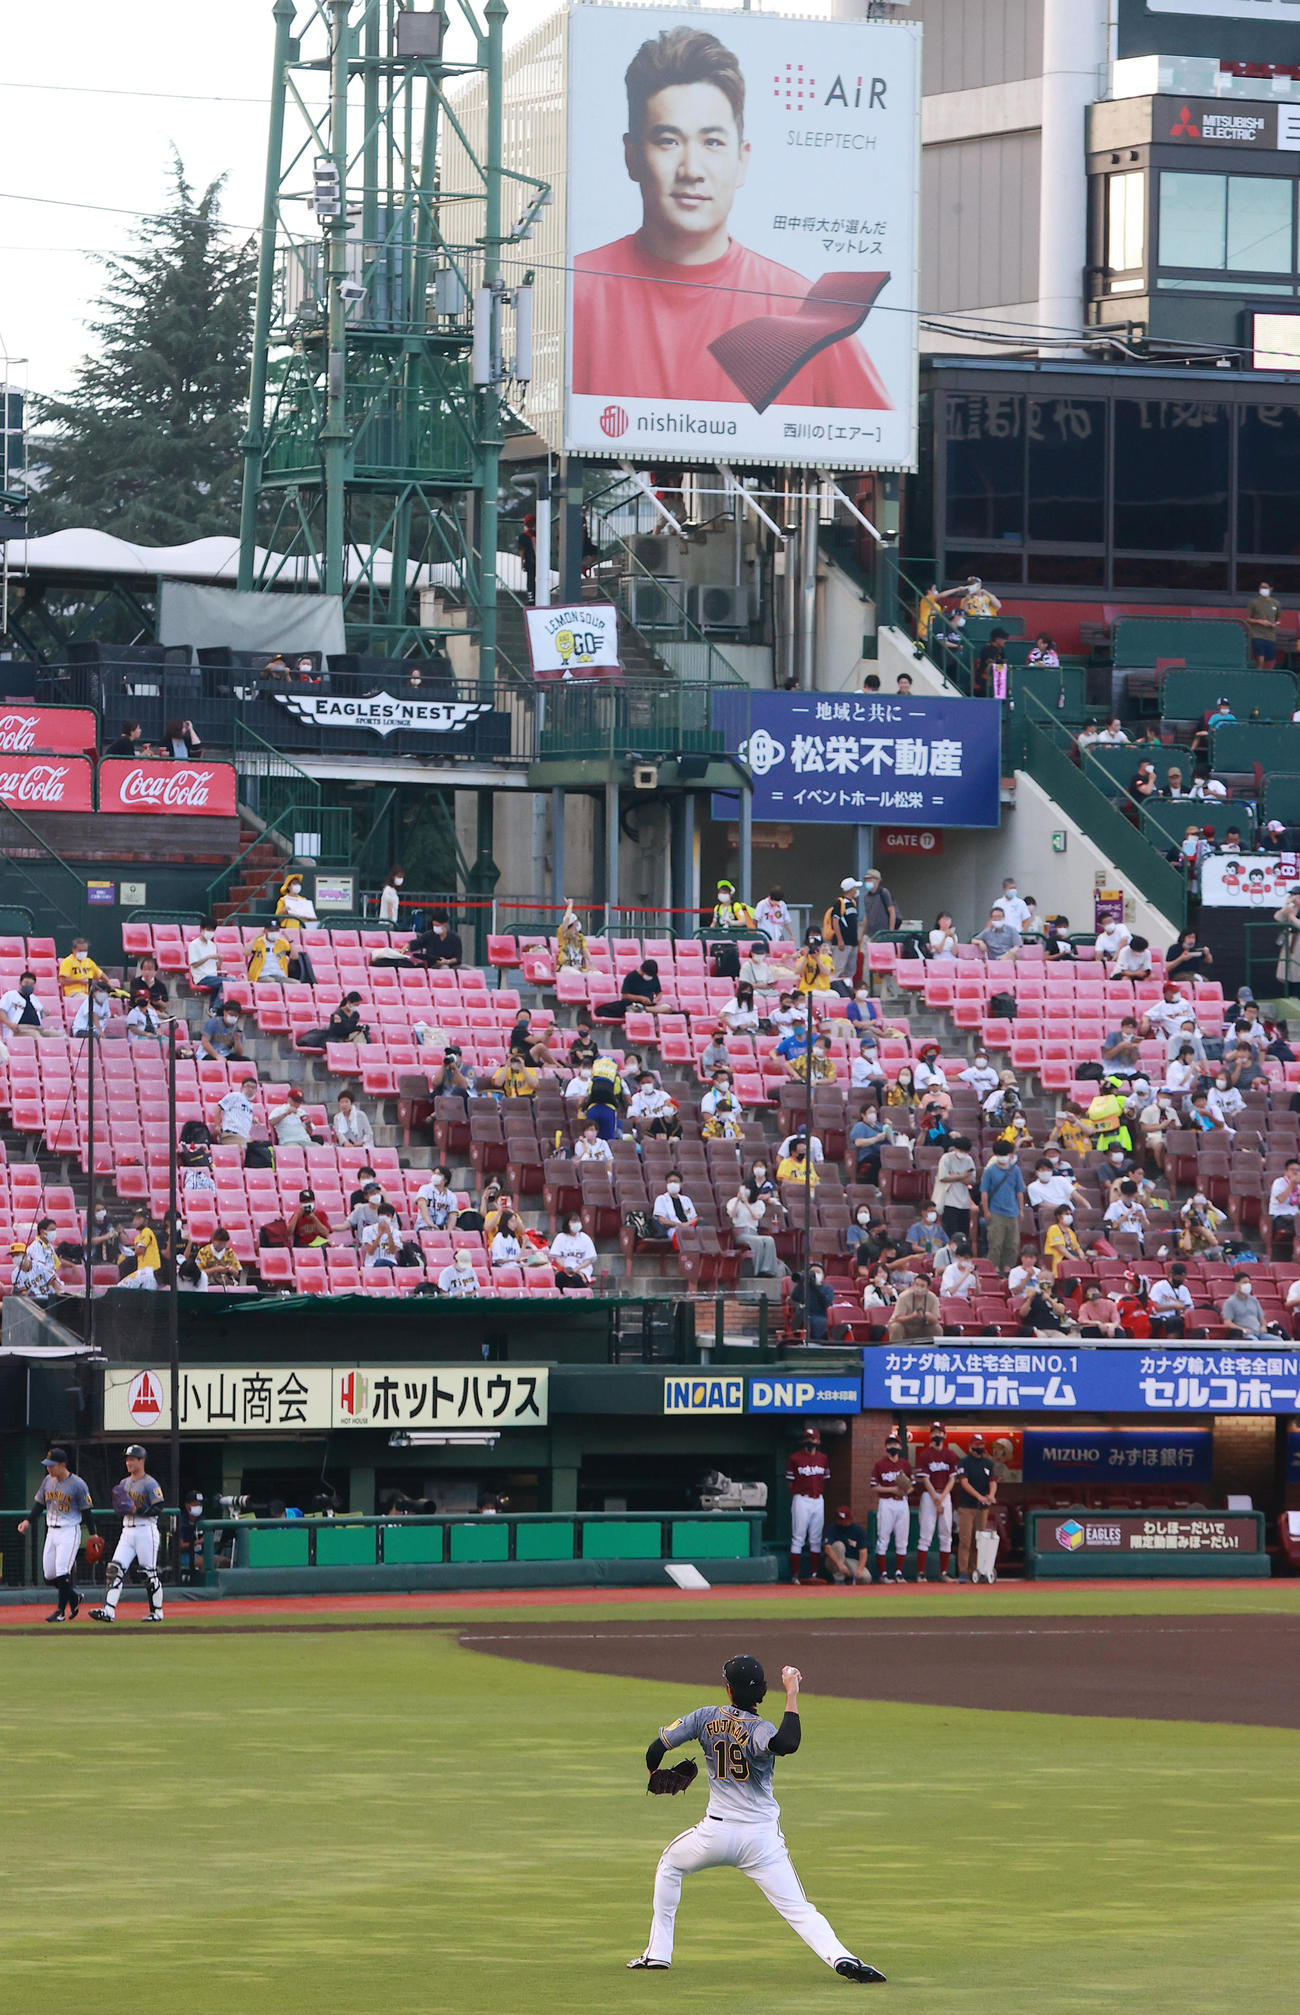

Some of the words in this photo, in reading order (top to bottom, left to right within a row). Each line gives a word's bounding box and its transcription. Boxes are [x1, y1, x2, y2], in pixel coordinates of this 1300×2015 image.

[1202, 115, 1264, 129] MITSUBISHI
[786, 130, 877, 149] SLEEPTECH
[1202, 127, 1256, 140] ELECTRIC
[773, 215, 887, 235] 田中将大が選んだ
[822, 239, 882, 254] マットレス
[637, 413, 737, 435] nishikawa
[784, 423, 881, 442] 西川の[エアー]
[545, 611, 578, 635] LEMON
[573, 632, 597, 655] GO
[815, 702, 902, 723] 地域と共に
[791, 734, 963, 777] 松栄不動産
[120, 768, 214, 806] Coca-Cola
[793, 788, 923, 809] イベントホール松栄
[887, 834, 918, 847] GATE
[886, 1353, 1078, 1374] カナダ輸入住宅全国NO.1
[1140, 1356, 1300, 1376] カナダ輸入住宅全国N
[178, 1372, 308, 1425] 小山商会
[373, 1374, 540, 1420] ホットハウス
[666, 1382, 741, 1409] INOAC
[752, 1383, 815, 1407] DNP
[816, 1390, 858, 1402] 大日本印刷
[885, 1375, 1077, 1406] セルコホーム
[1139, 1378, 1300, 1408] セルコホー
[1043, 1447, 1100, 1463] MIZUHO
[1108, 1447, 1195, 1467] みずほ銀行
[1086, 1528, 1121, 1540] EAGLES
[1144, 1521, 1225, 1535] わしほーだいで
[706, 1719, 749, 1746] FUJINAM
[713, 1739, 750, 1782] 19
